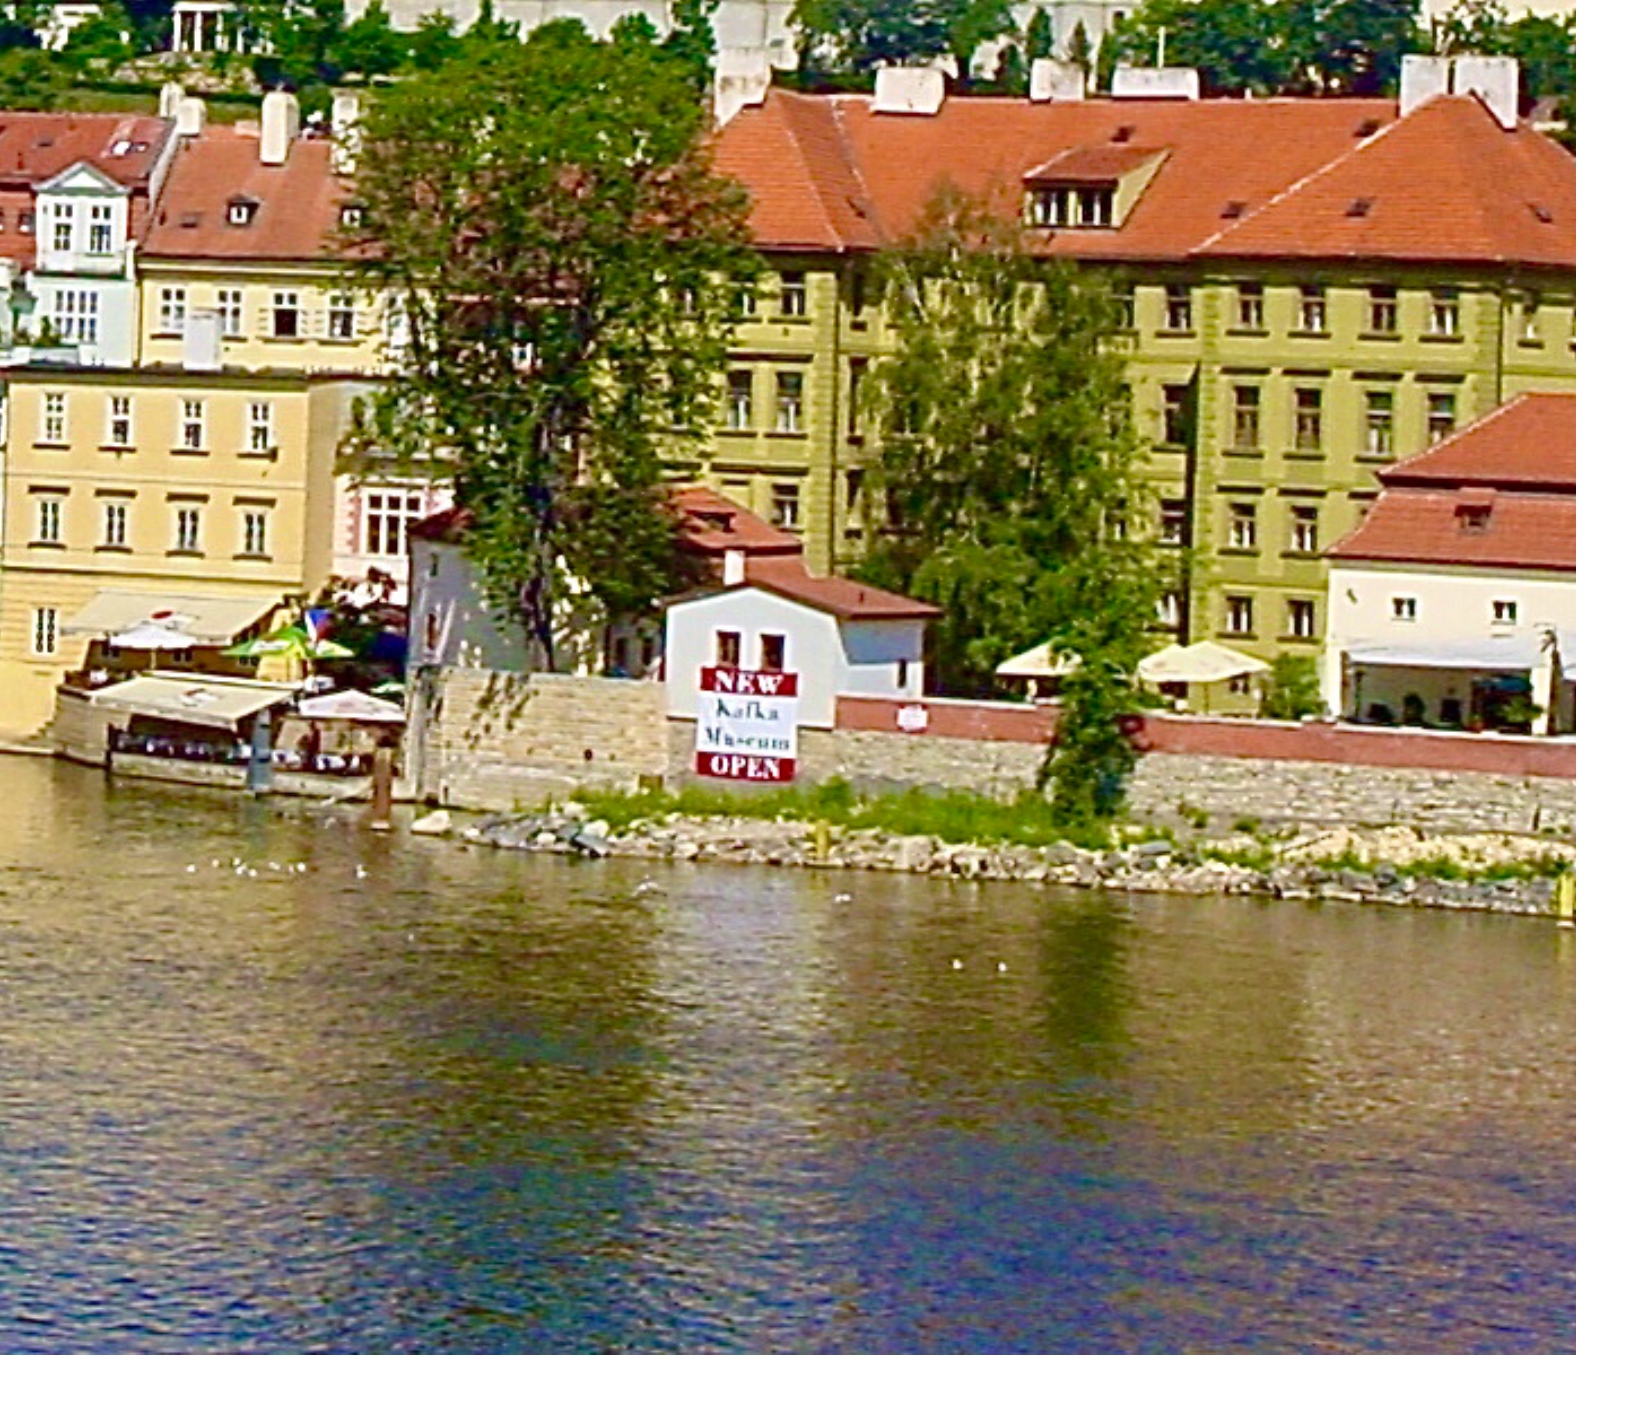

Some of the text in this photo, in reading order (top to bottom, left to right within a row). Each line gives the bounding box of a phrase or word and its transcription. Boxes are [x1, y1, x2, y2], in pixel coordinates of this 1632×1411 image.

[714, 669, 784, 694] NEW
[716, 698, 779, 720] Kafka
[710, 755, 781, 779] OPEN
